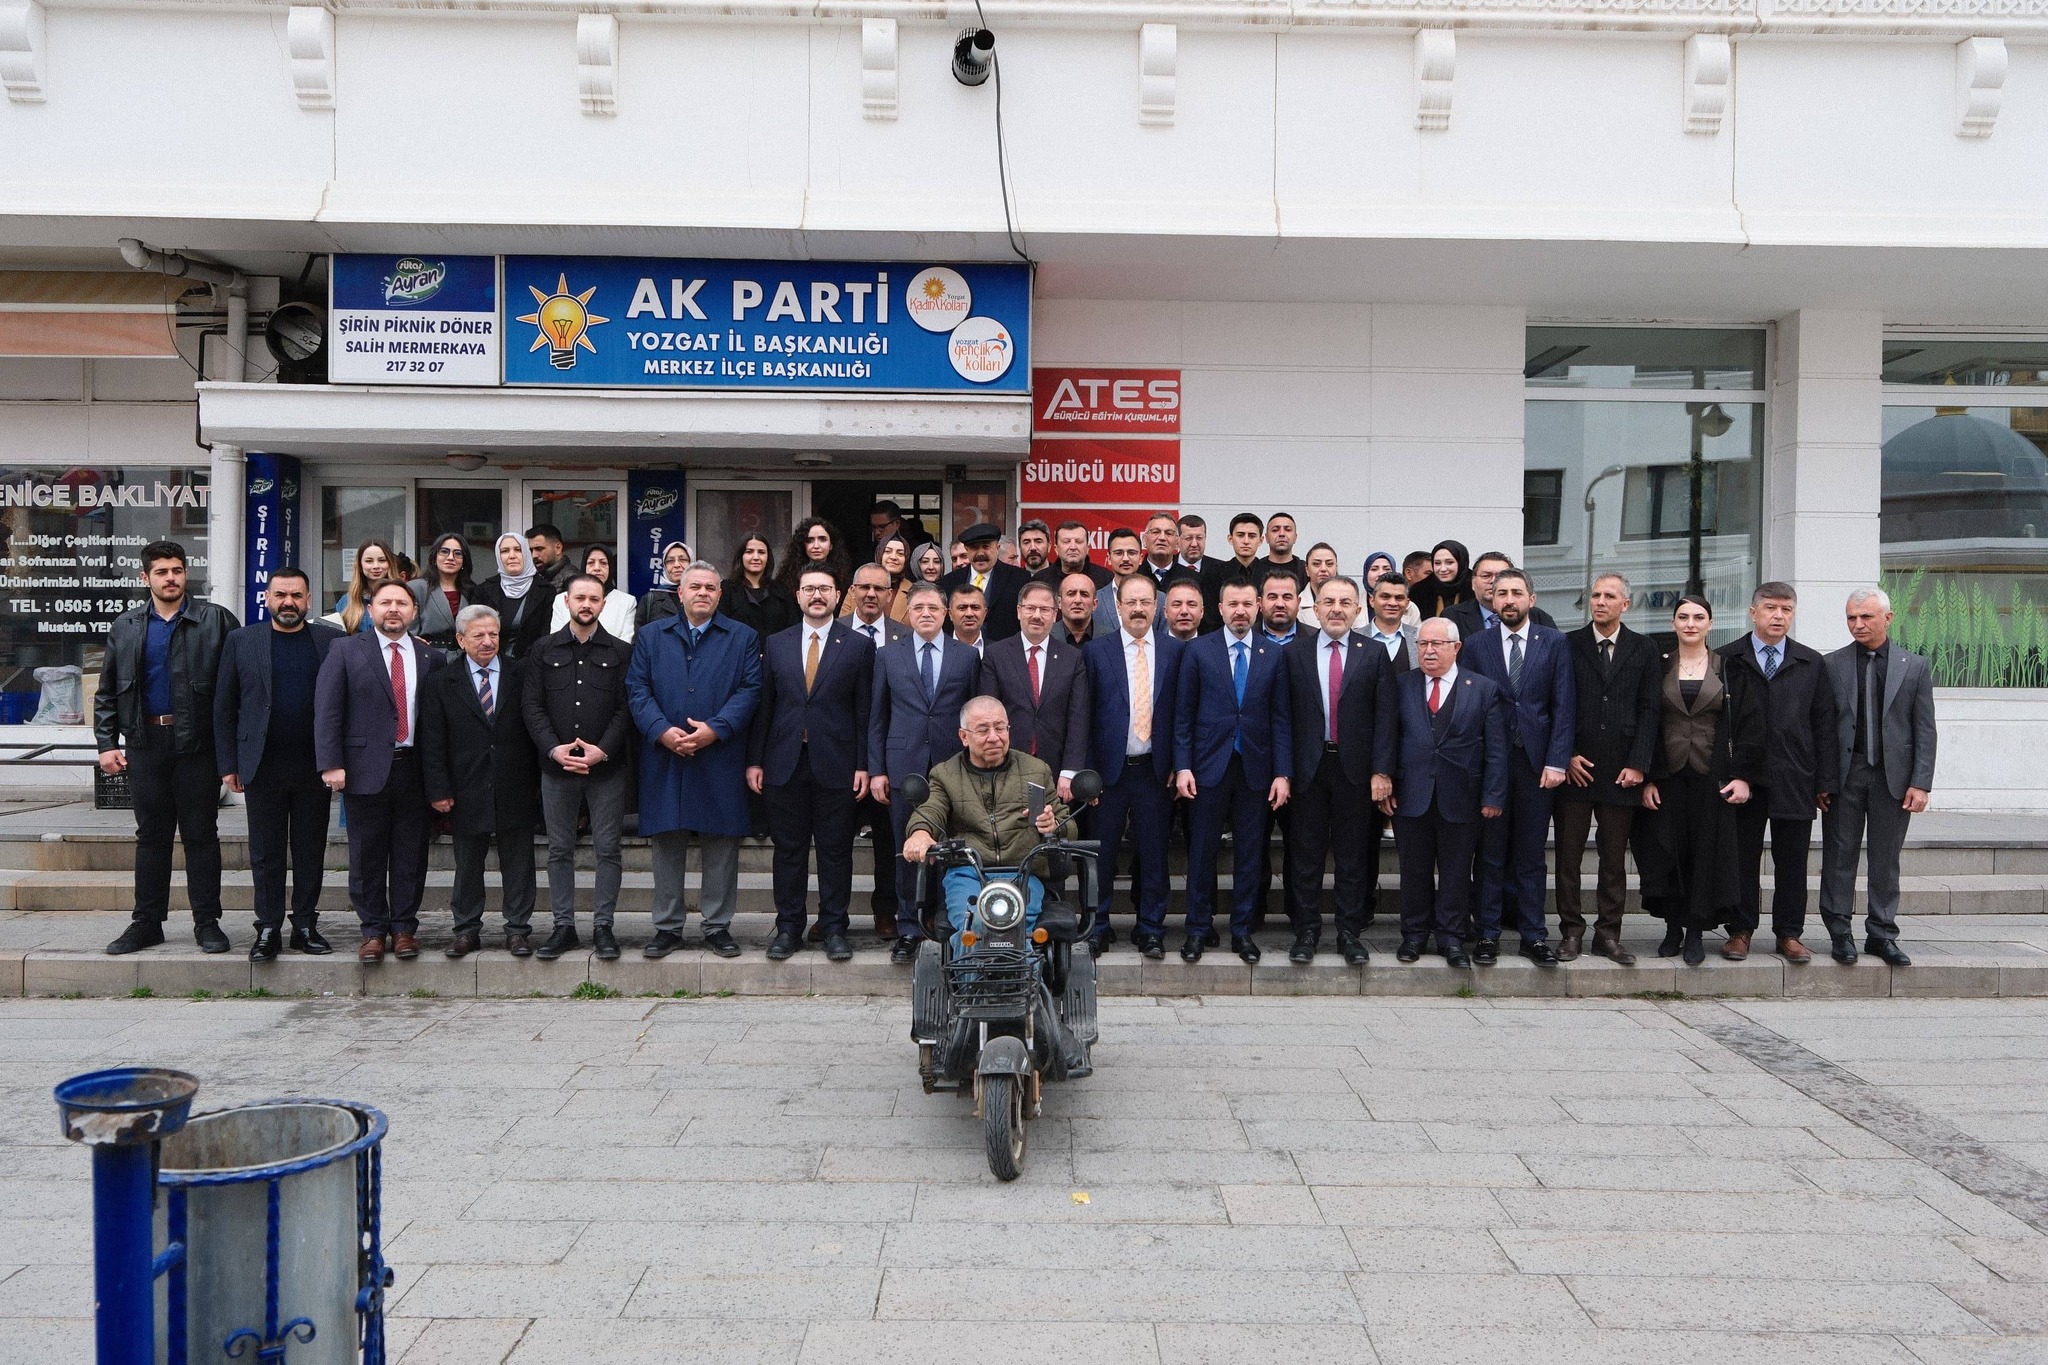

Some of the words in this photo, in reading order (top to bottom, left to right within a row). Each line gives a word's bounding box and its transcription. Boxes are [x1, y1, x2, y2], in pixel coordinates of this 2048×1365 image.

[392, 268, 438, 294] Ayran
[626, 278, 708, 321] AK
[732, 272, 889, 323] PARTİ
[940, 297, 968, 312] Kolları
[339, 315, 380, 335] ŞİRİN
[384, 316, 436, 334] PİKNİK
[440, 316, 493, 335] DÖNER
[345, 338, 385, 354] SALİH
[388, 342, 486, 356] MERMERKAYA
[627, 332, 718, 353] YOZGAT
[727, 328, 746, 354] İL
[754, 330, 889, 358] BAŞKANLIĞI
[954, 344, 990, 361] gençlik
[386, 360, 407, 373] 217
[409, 361, 426, 373] 32
[428, 361, 445, 373] 07
[644, 360, 715, 377] MERKEZ
[721, 357, 756, 380] İLÇE
[763, 358, 871, 381] BAŞKANLIĞI
[966, 356, 1000, 371] kolları
[1053, 411, 1090, 422] SÜRÜCÜ
[1091, 411, 1123, 421] EĞİTİM
[1125, 412, 1177, 423] KURUMLARI
[1026, 458, 1104, 483] SÜRÜCÜ
[1112, 463, 1175, 483] KURSU
[0, 480, 71, 508] NİCE
[78, 480, 211, 508] BAKLİYAT
[642, 493, 674, 512] Ayran
[284, 508, 292, 568] ŞİRİ
[18, 555, 77, 567] Sofranıza
[79, 555, 107, 567] Yerli
[185, 555, 208, 567] Tab
[650, 527, 662, 585] ŞİRİ
[0, 574, 80, 588] Ürünlerimizle
[10, 600, 41, 613] TEL
[55, 599, 92, 613] 0505
[96, 600, 124, 613] 125
[38, 621, 87, 633] Mustafa
